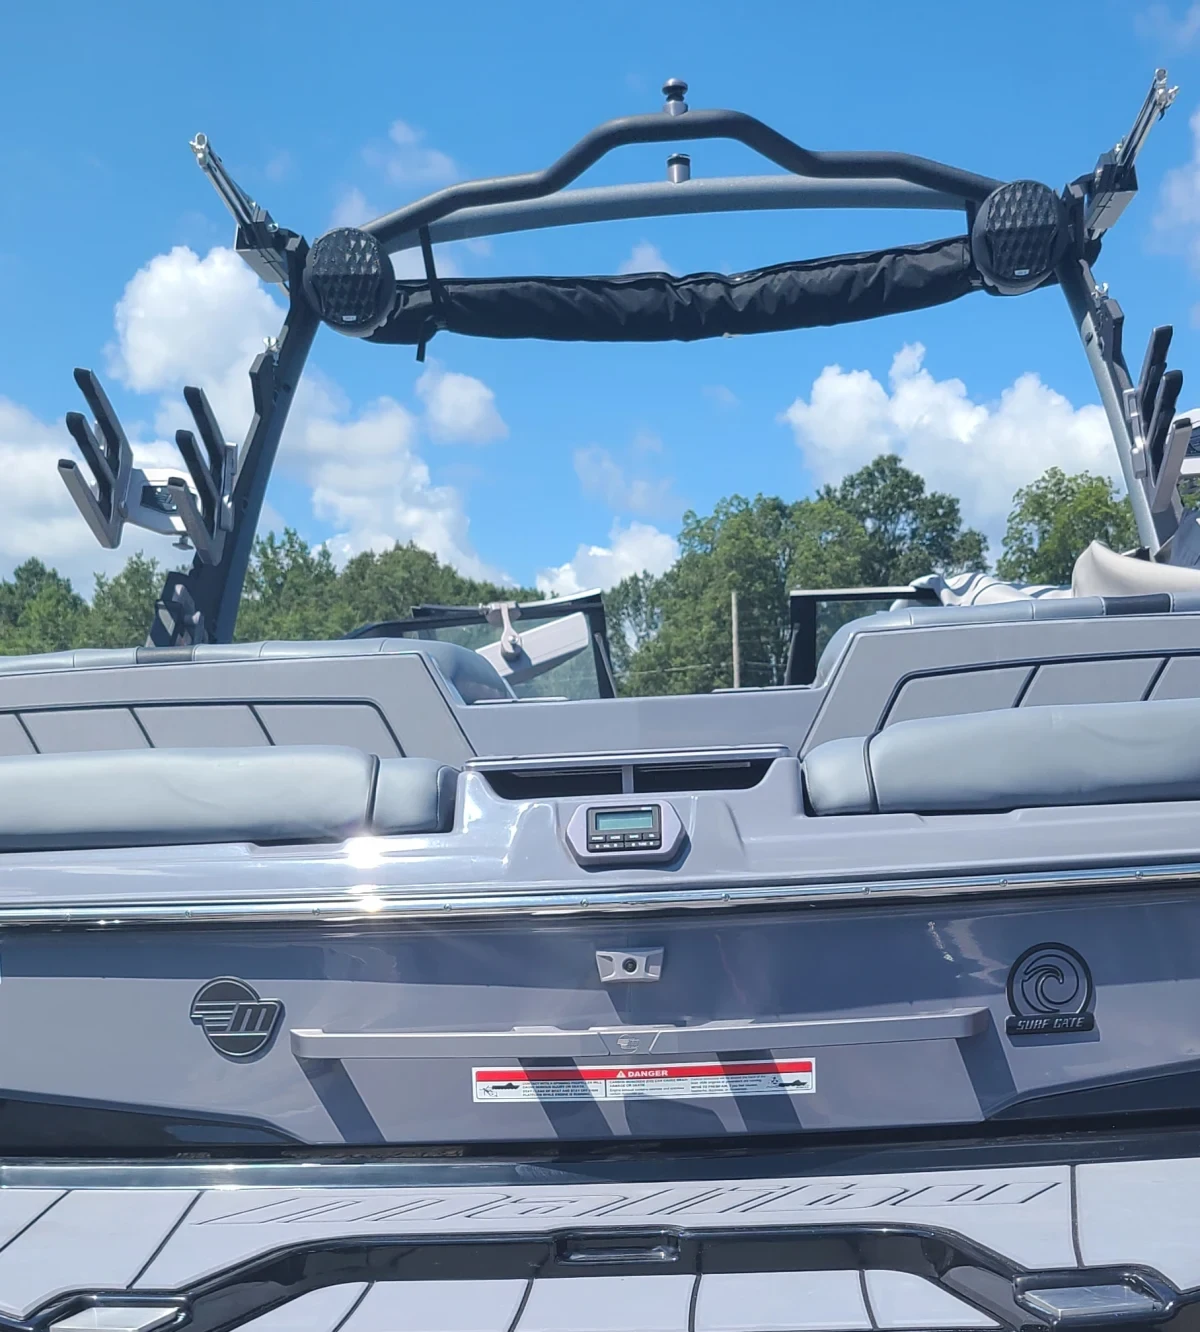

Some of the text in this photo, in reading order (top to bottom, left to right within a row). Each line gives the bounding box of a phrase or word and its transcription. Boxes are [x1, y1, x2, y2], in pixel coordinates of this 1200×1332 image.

[1016, 1017, 1085, 1030] SURF GATE
[627, 1069, 669, 1078] DANGER
